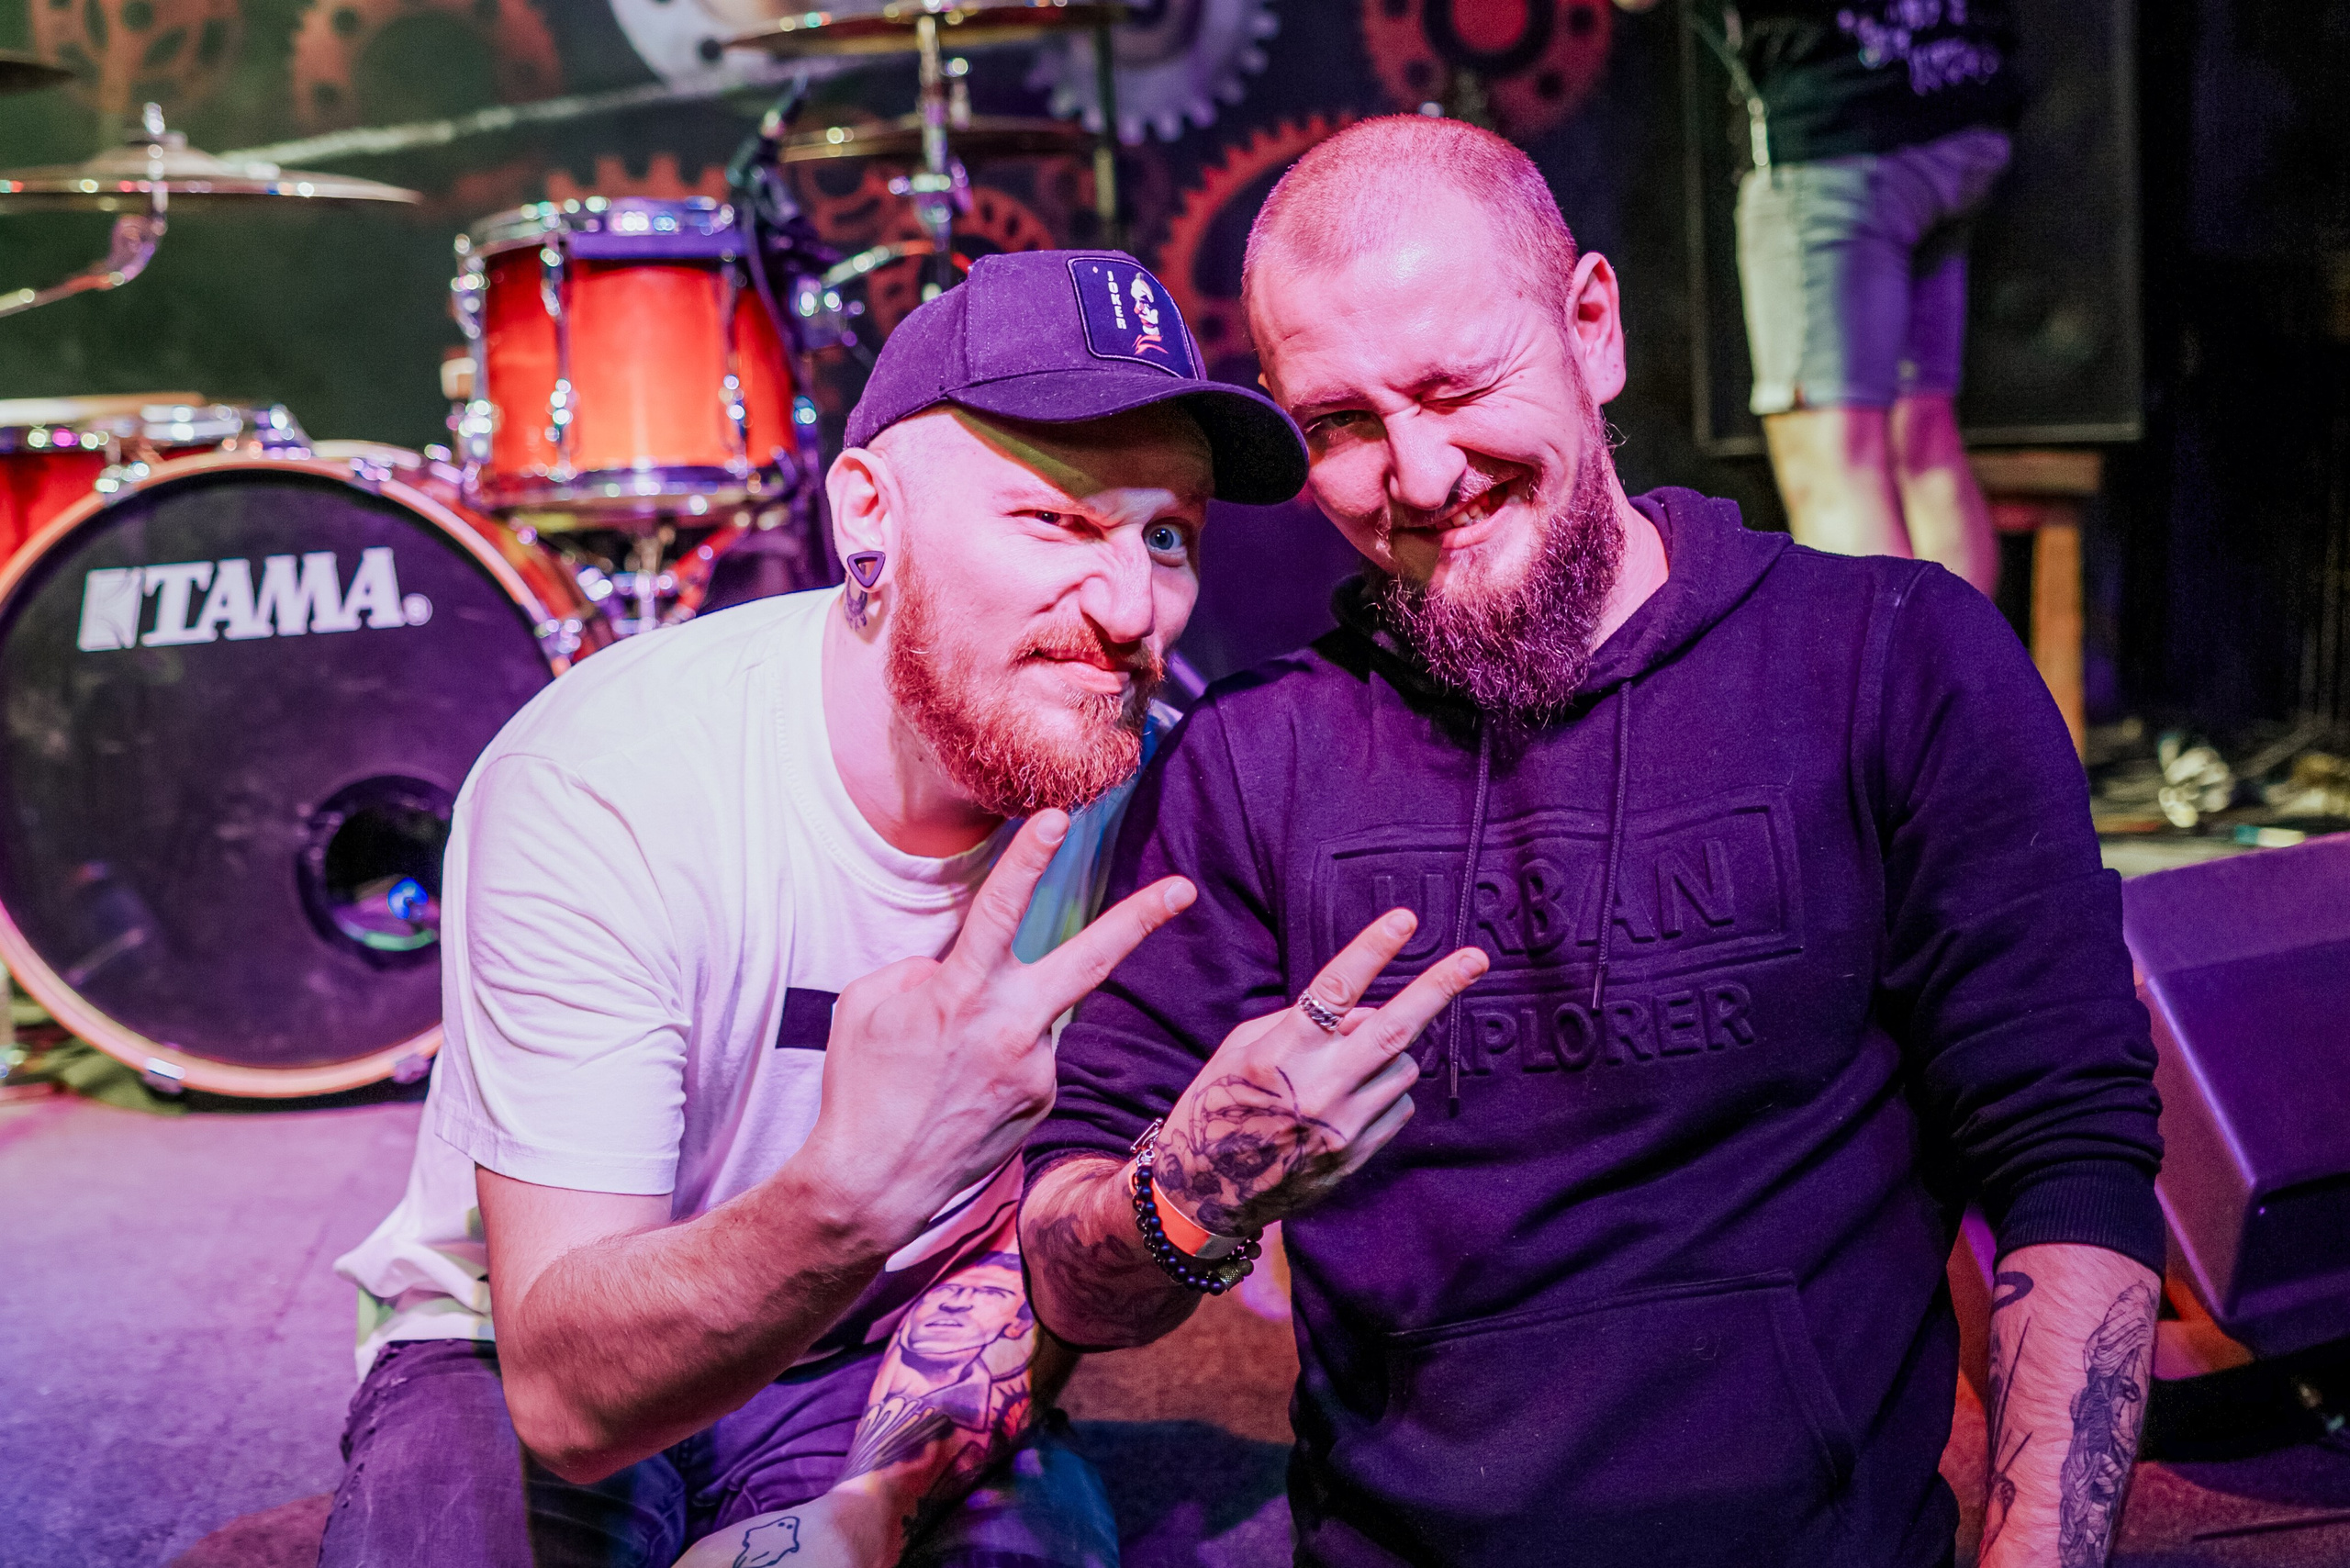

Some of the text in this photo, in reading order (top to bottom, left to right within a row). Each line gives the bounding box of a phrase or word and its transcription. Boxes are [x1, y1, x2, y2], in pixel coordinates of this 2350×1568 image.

[1106, 270, 1127, 330] JOKER
[140, 547, 406, 647] TAMA
[1371, 836, 1736, 961] URBAN
[1416, 980, 1756, 1079] XPLORER
